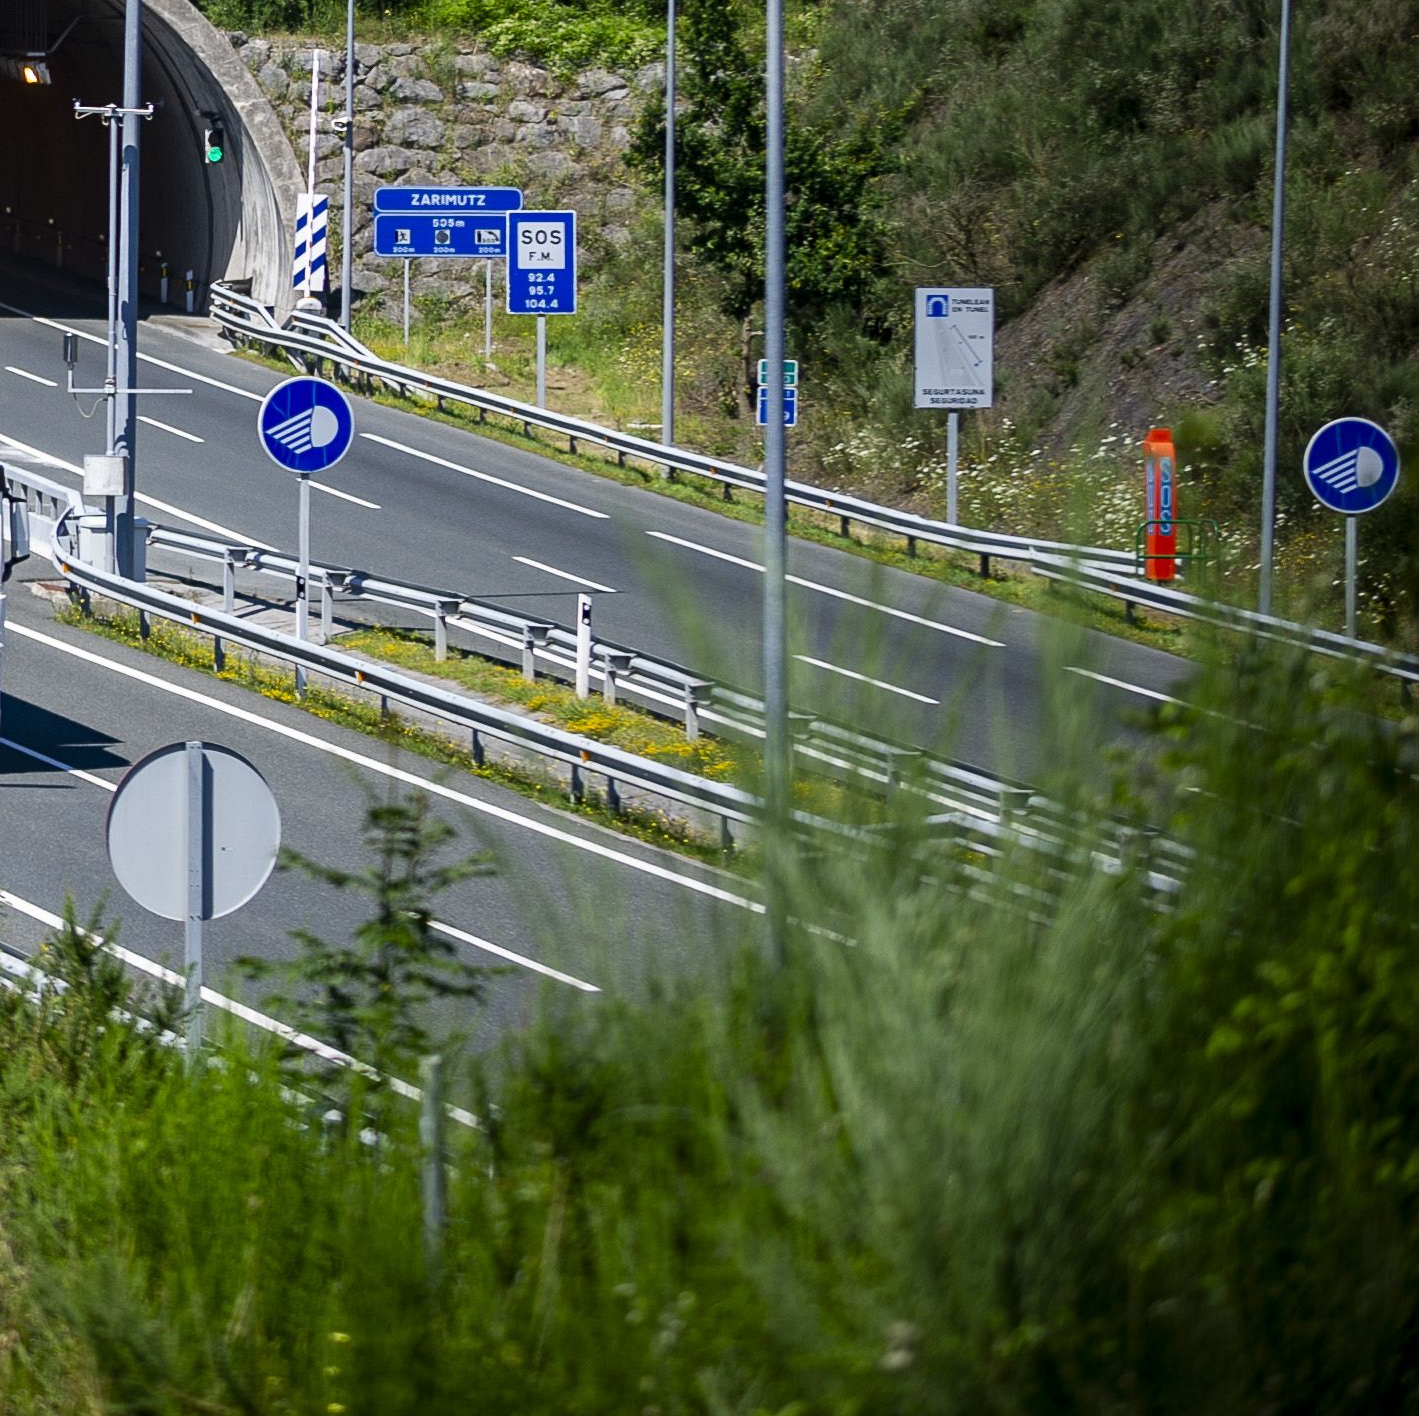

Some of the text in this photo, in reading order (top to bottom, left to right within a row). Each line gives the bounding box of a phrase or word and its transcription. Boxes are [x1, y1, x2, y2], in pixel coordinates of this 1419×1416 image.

[411, 193, 486, 206] ZARIMUTZ
[521, 229, 562, 245] SOS
[529, 251, 554, 261] F.M.
[527, 272, 556, 282] 92.4
[528, 285, 555, 296] 95.7
[525, 299, 559, 309] 104.4
[922, 388, 986, 396] SEGURTASUNA
